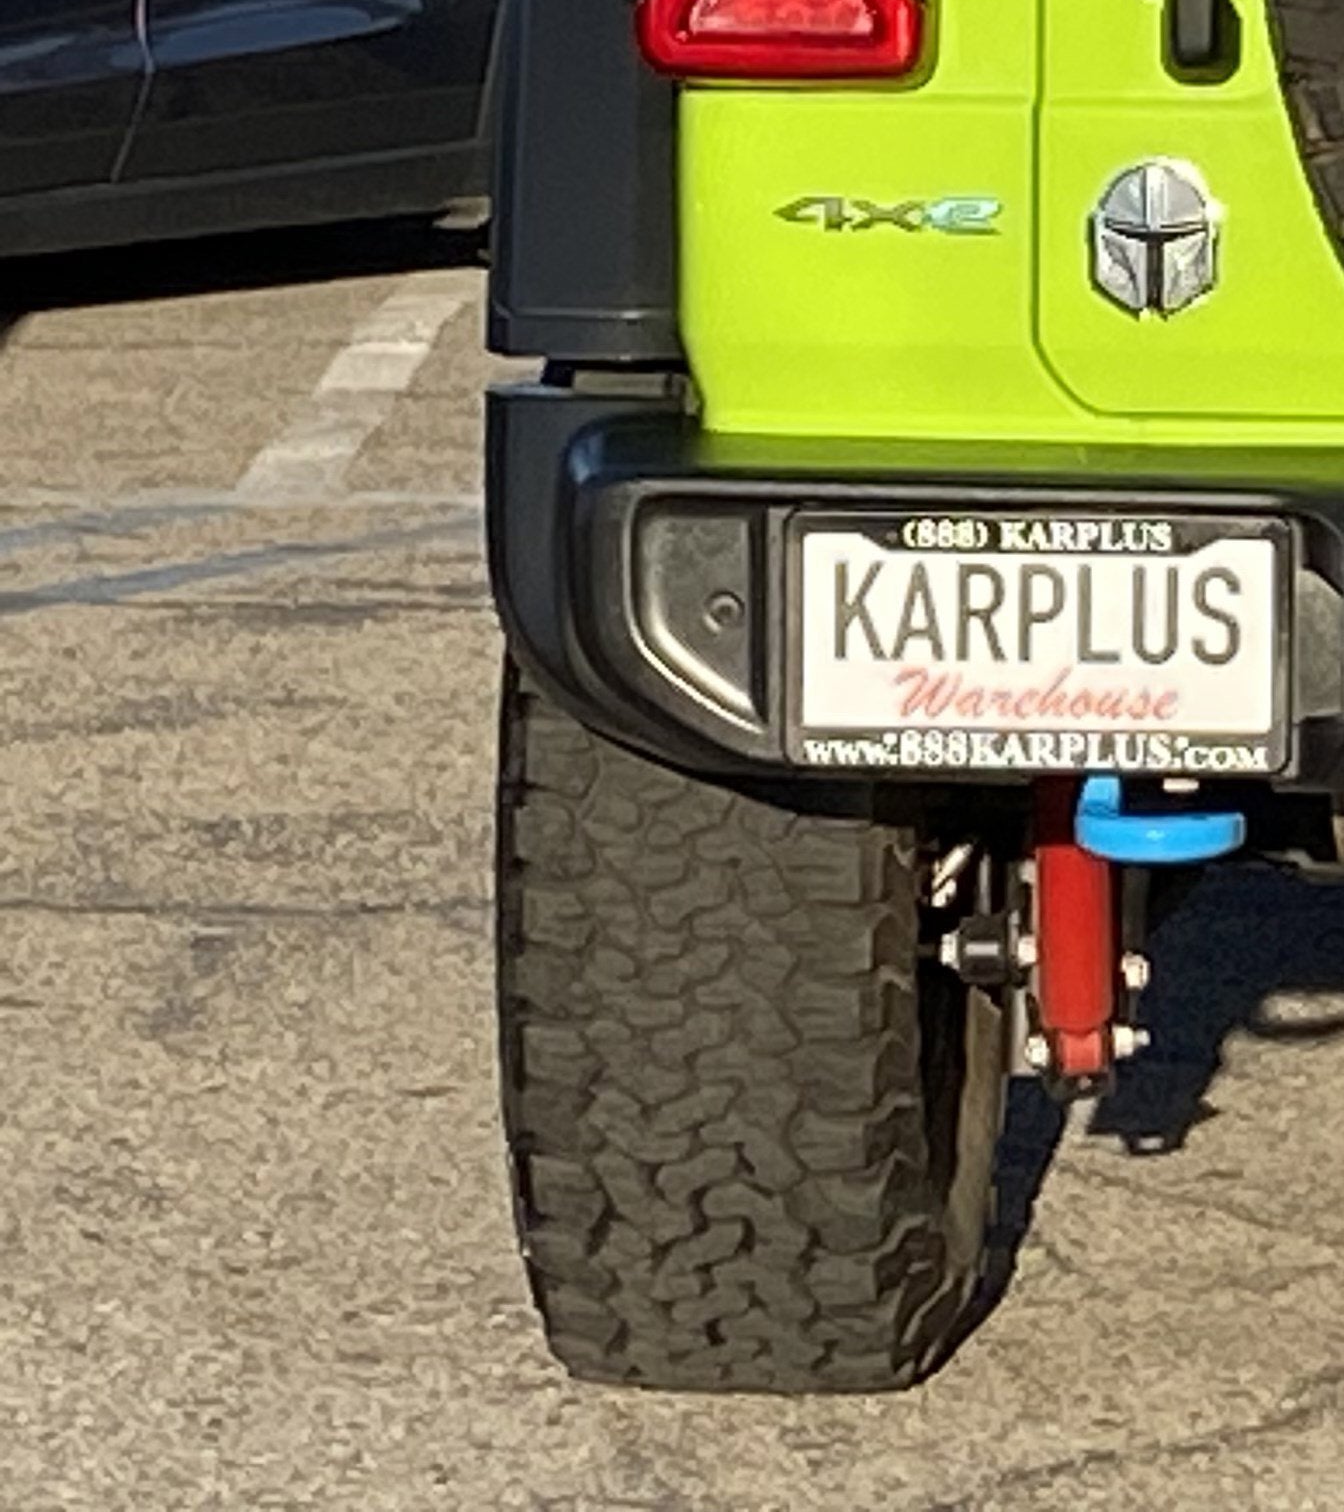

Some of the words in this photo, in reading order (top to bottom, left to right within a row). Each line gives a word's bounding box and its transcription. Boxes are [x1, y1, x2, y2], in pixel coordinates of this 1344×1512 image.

[902, 518, 988, 548] (888)
[999, 520, 1173, 552] KARPLUS
[833, 558, 1243, 666] KARPLUS
[890, 664, 1182, 722] Warehouse
